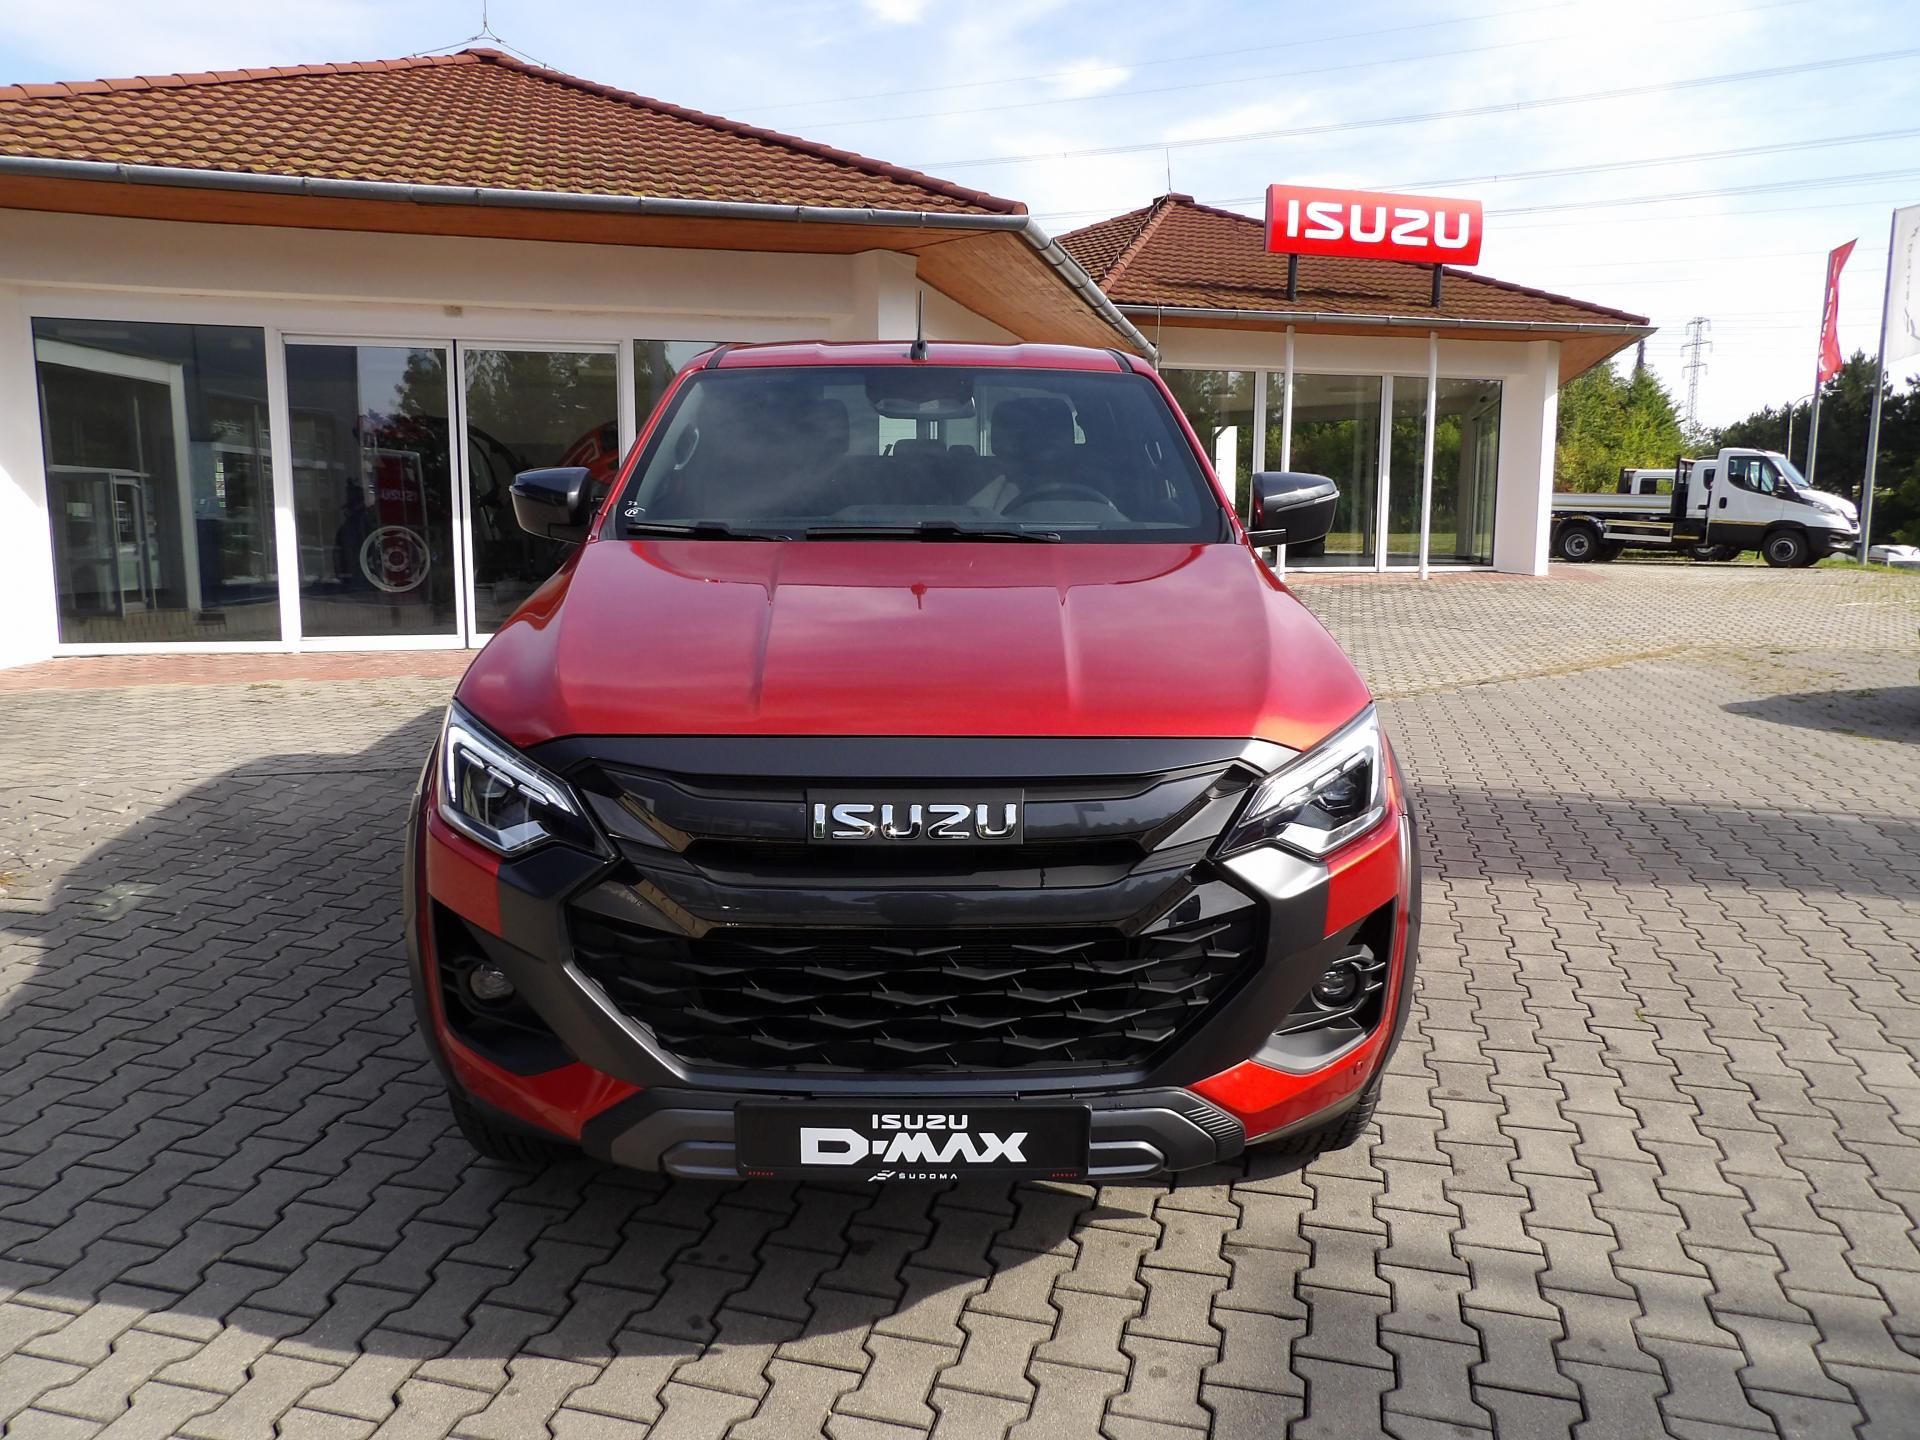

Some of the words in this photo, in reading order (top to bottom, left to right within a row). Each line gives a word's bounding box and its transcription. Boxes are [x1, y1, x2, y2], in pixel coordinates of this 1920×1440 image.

[1286, 199, 1470, 249] ISUZU
[813, 803, 1017, 839] ISUZU
[872, 1114, 968, 1129] ISUZU
[800, 1127, 1028, 1165] D-MAX
